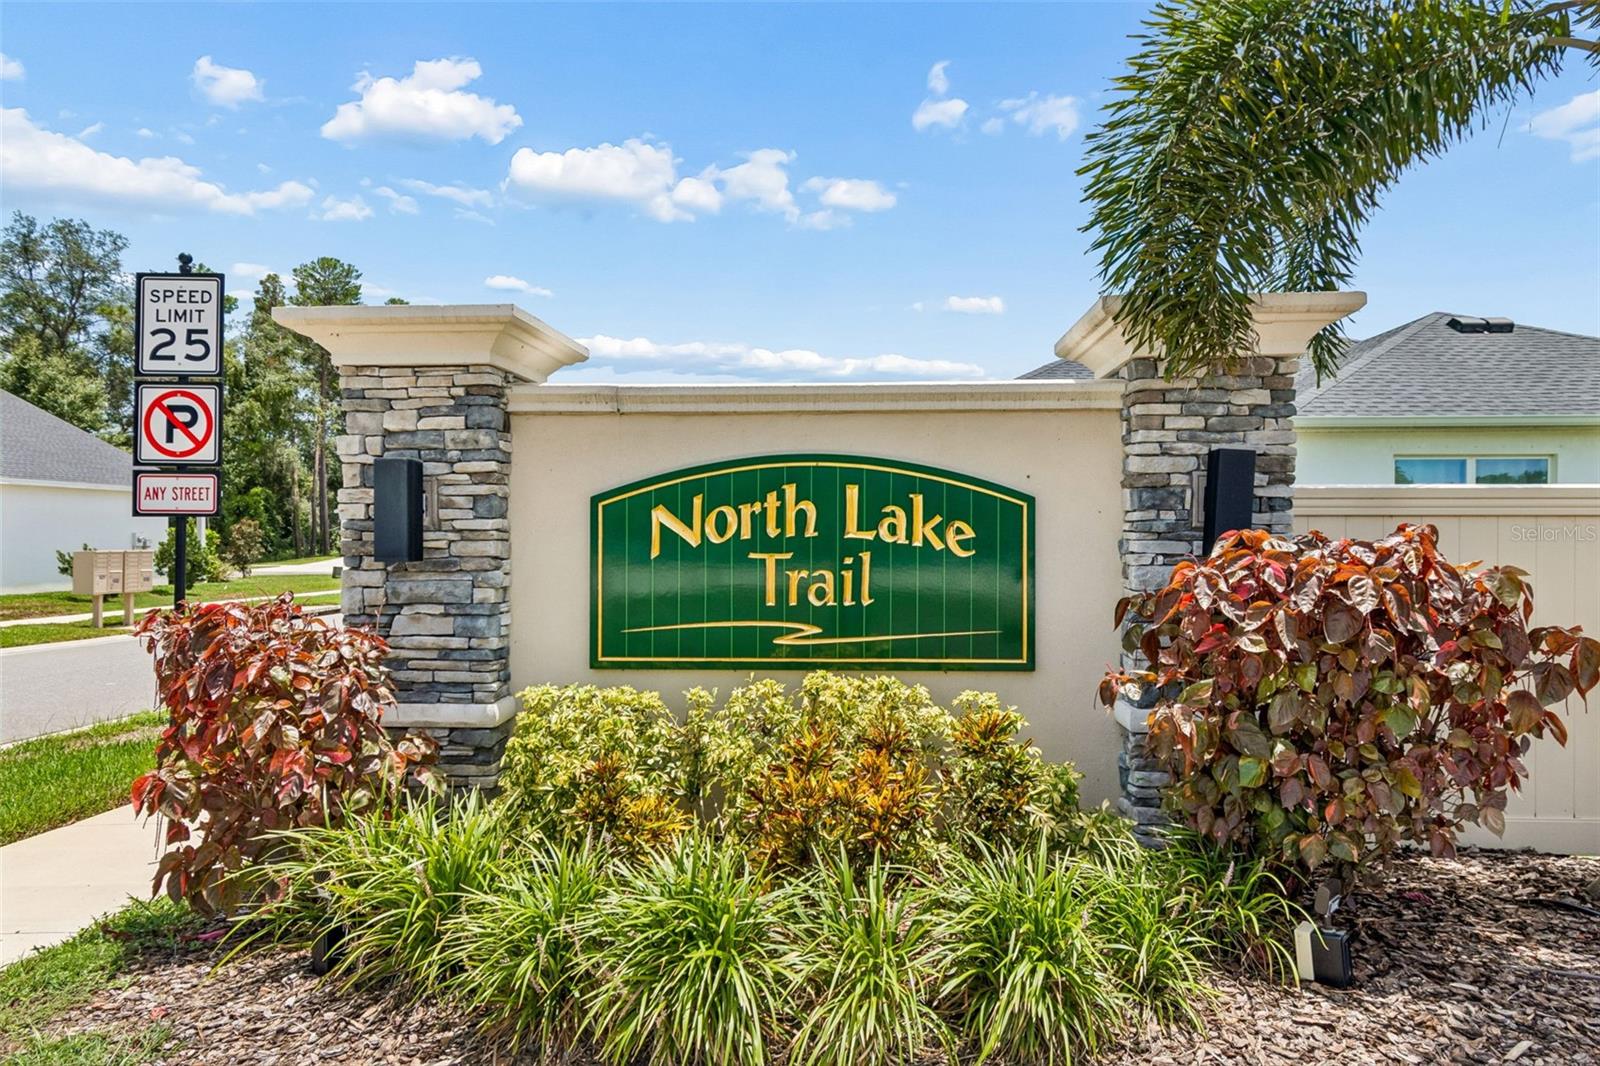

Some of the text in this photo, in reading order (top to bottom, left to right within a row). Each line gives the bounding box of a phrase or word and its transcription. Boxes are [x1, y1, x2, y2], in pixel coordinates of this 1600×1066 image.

[150, 289, 212, 304] SPEED
[156, 309, 205, 323] LIMIT
[149, 328, 211, 362] 25
[165, 405, 199, 443] P
[144, 487, 211, 501] ANY STREET
[650, 483, 977, 560] North Lake
[748, 551, 875, 607] Trail
